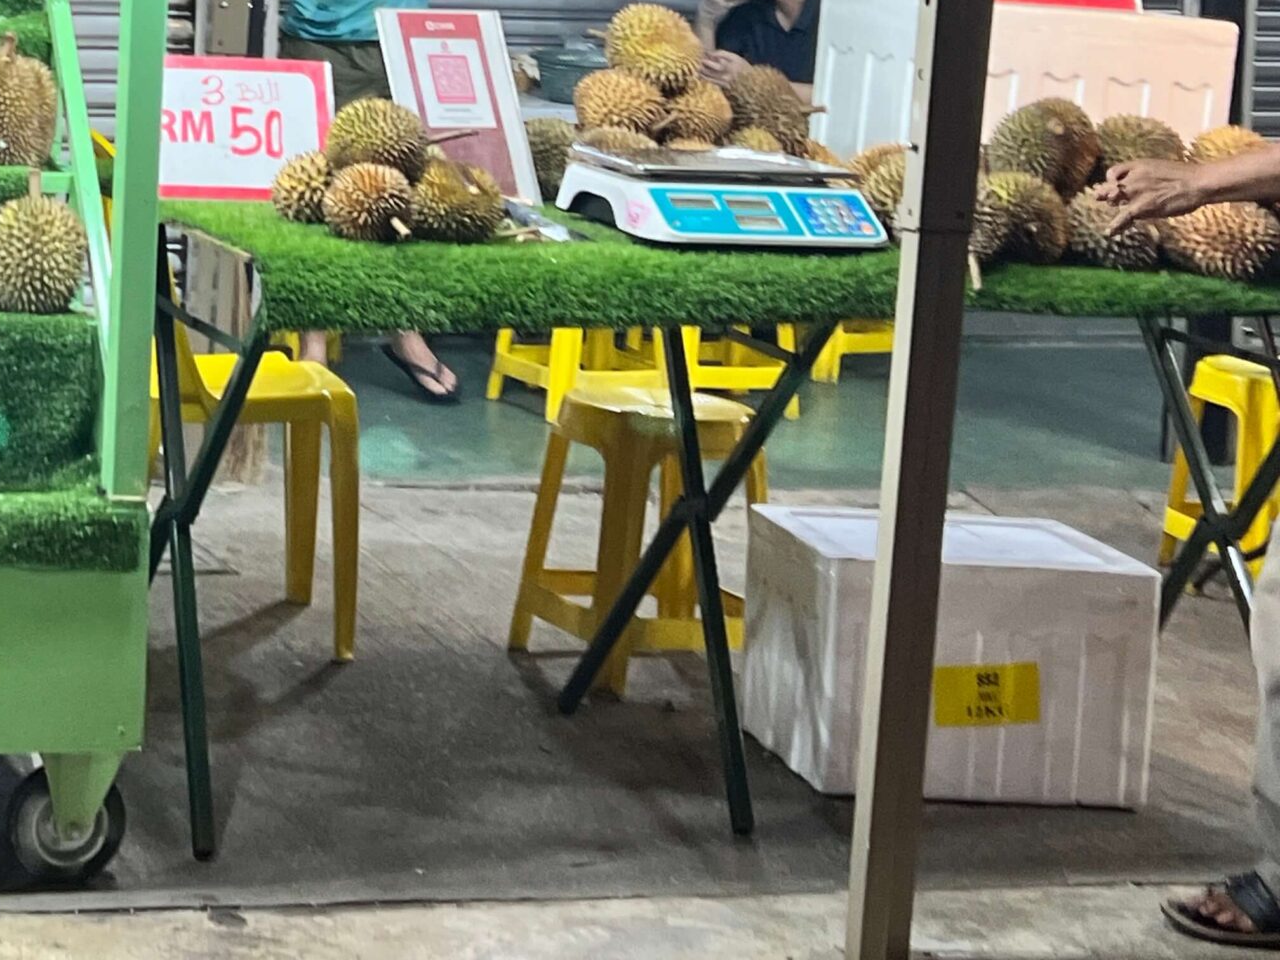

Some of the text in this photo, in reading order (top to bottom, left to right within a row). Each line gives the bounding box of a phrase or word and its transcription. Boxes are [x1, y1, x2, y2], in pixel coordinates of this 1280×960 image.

[201, 75, 225, 106] 3
[161, 105, 284, 160] RM 50
